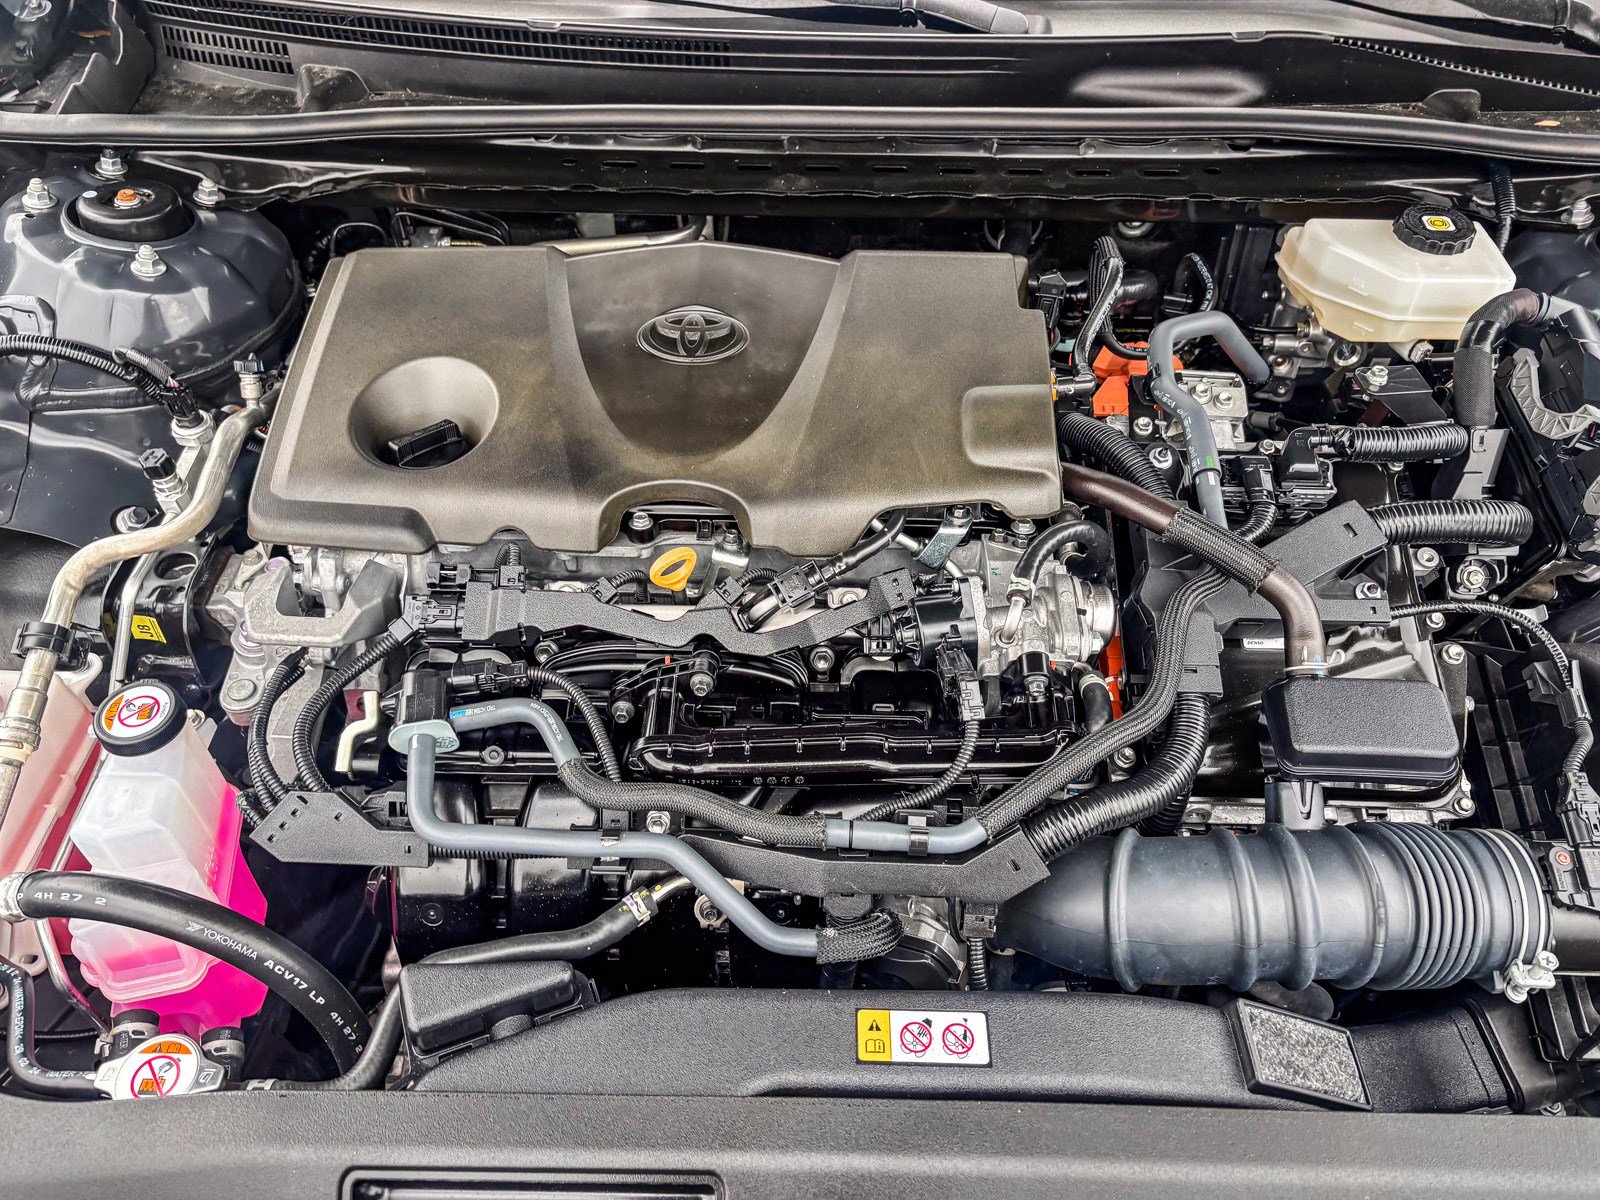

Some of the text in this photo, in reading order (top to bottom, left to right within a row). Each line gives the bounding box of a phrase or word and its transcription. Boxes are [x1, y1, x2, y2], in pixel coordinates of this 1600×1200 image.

[137, 624, 154, 638] J8
[34, 891, 54, 901] 4H
[60, 892, 83, 902] 27
[94, 897, 107, 906] 2
[203, 927, 363, 1054] YOKOHAMA ACV17 LP 4H 27 2
[14, 986, 25, 1012] WATER
[45, 1070, 75, 1079] WATER
